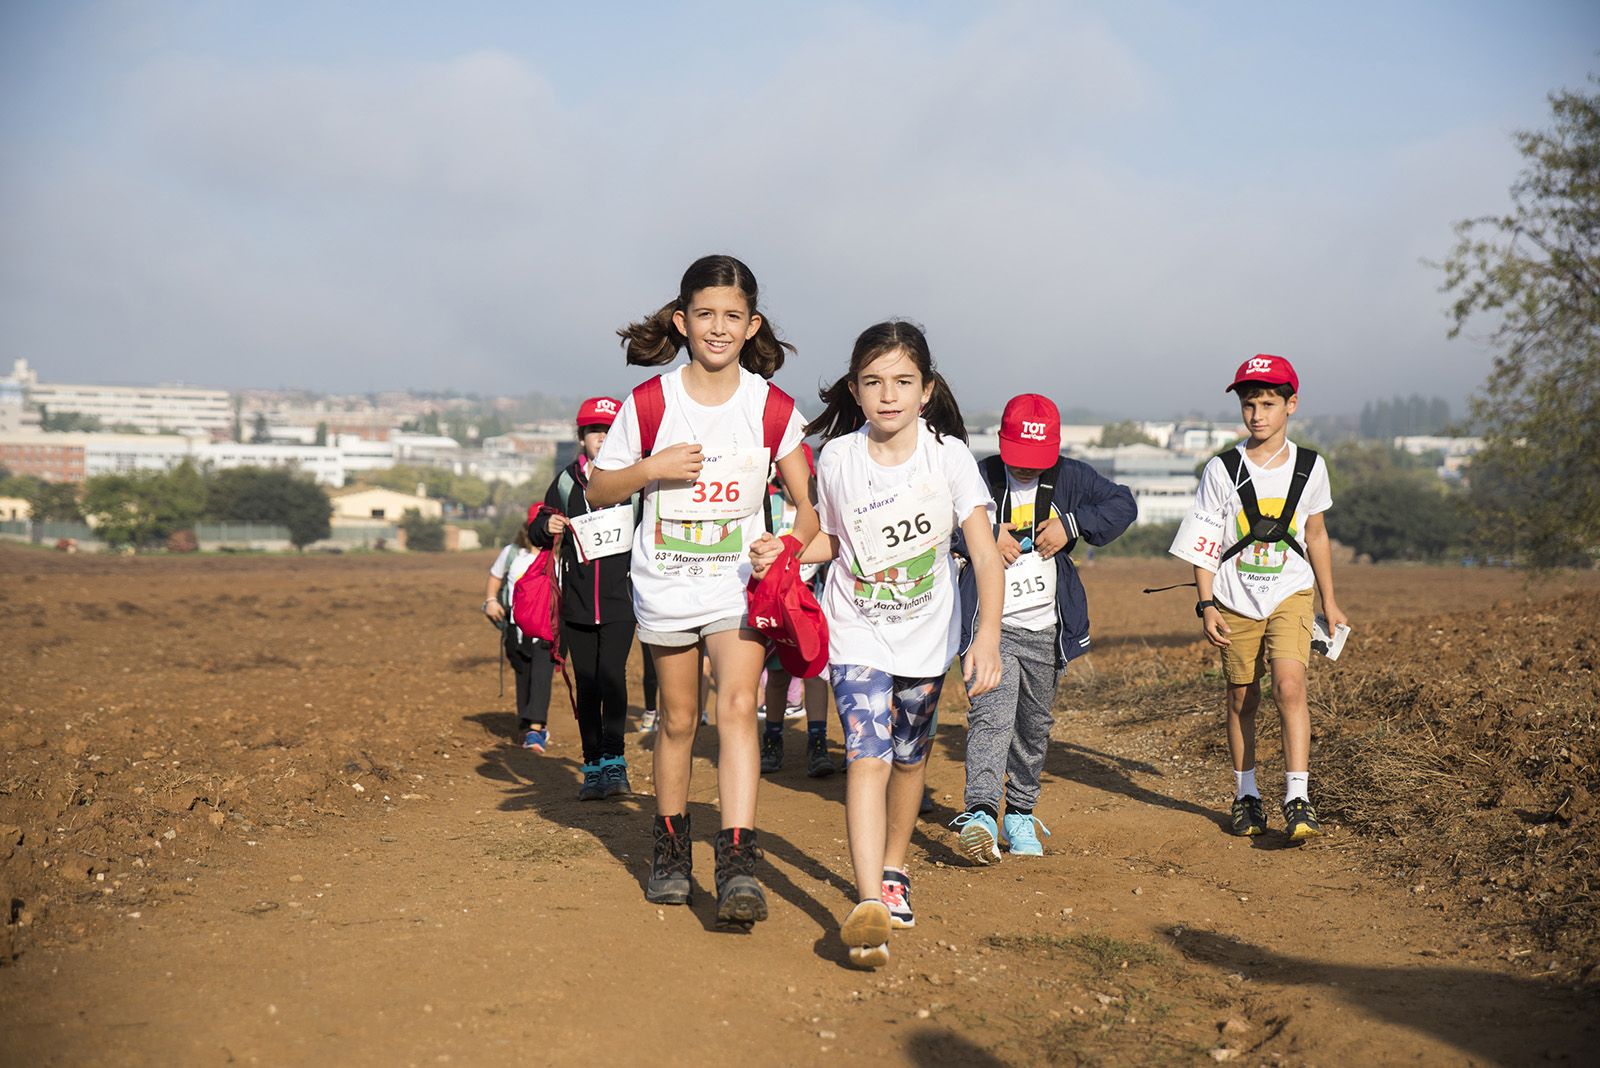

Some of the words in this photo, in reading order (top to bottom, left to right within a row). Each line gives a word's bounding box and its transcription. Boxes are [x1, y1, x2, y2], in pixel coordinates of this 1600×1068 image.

[1248, 358, 1272, 368] TOT
[597, 399, 616, 410] TOT
[1022, 421, 1046, 434] TOT
[692, 481, 740, 503] 326
[592, 528, 621, 546] 327
[881, 513, 931, 548] 326
[673, 554, 704, 563] Marxa
[704, 554, 740, 562] Infantil
[1010, 575, 1045, 597] 315
[904, 592, 932, 610] Infantil
